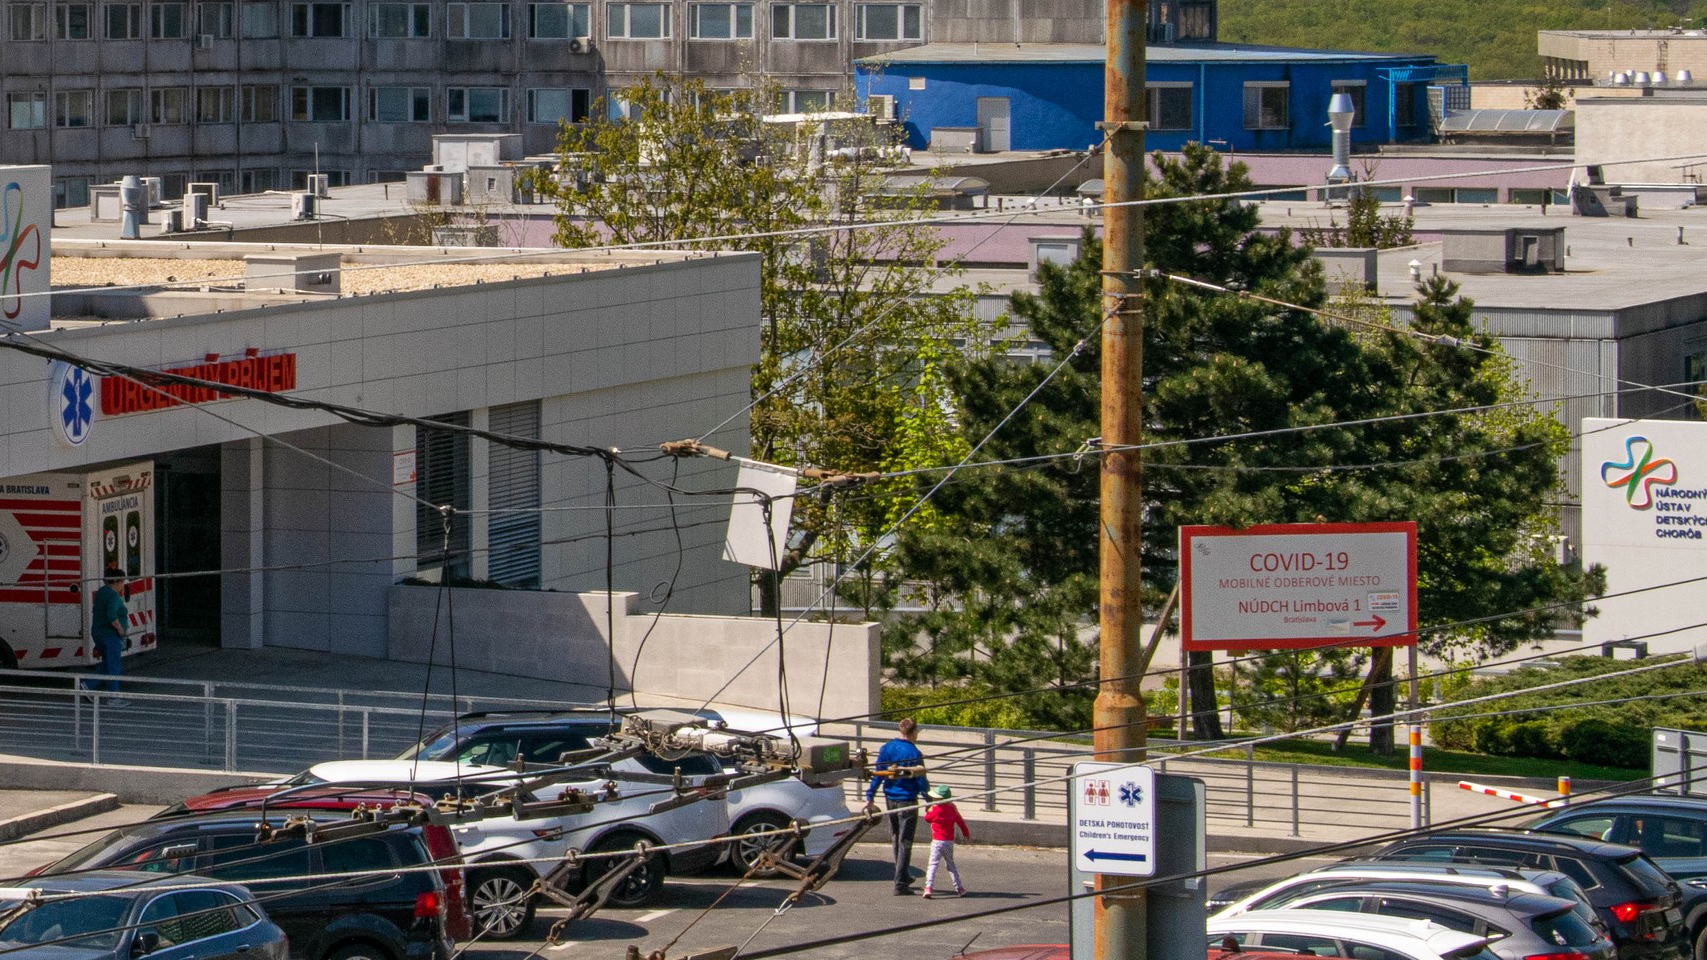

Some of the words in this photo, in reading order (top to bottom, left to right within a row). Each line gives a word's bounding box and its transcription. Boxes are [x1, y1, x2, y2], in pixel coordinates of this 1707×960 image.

[225, 348, 296, 399] PRÍJEM
[6, 485, 50, 495] BRATISLAVA
[1655, 501, 1691, 512] ÚSTAV
[1655, 528, 1702, 539] CHORÔB
[1249, 552, 1349, 572] COVID-19
[1219, 577, 1270, 589] MOBILNÉ
[1274, 576, 1335, 588] ODBEROVÉ
[1338, 576, 1381, 586] MIESTO
[1238, 598, 1289, 613] NÚDCH
[1293, 599, 1349, 612] Limbová
[1353, 599, 1361, 611] 1
[1284, 615, 1317, 624] Bratislava
[1079, 831, 1111, 839] Children's
[1114, 832, 1150, 842] Emergency
